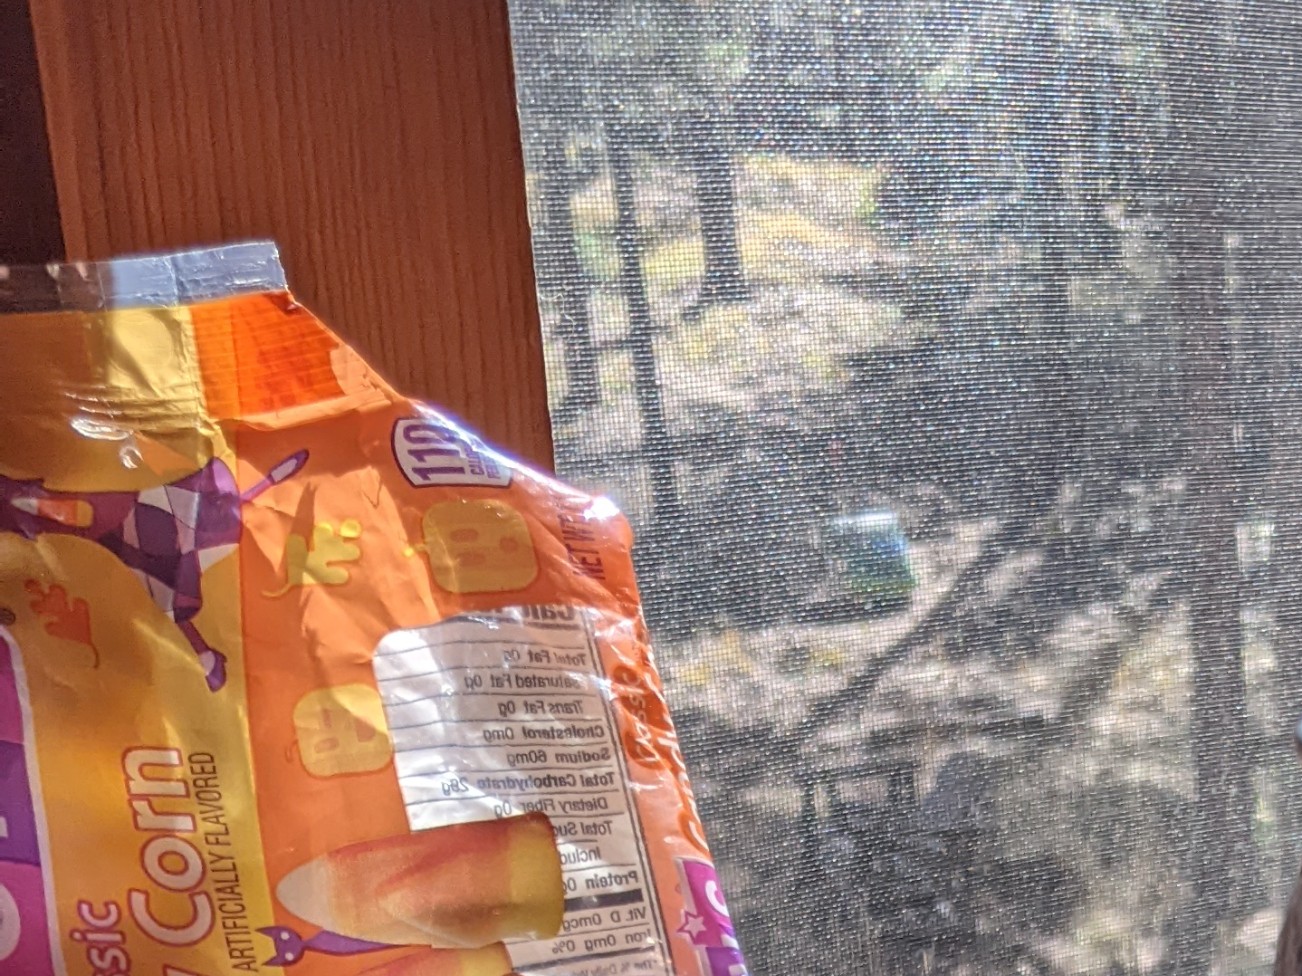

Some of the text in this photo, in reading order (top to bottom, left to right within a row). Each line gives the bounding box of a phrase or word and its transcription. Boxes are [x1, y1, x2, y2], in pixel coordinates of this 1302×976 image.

[403, 424, 466, 480] 110
[122, 746, 215, 948] Corn
[187, 752, 258, 972] ARTIFICIALLY FLAVORED
